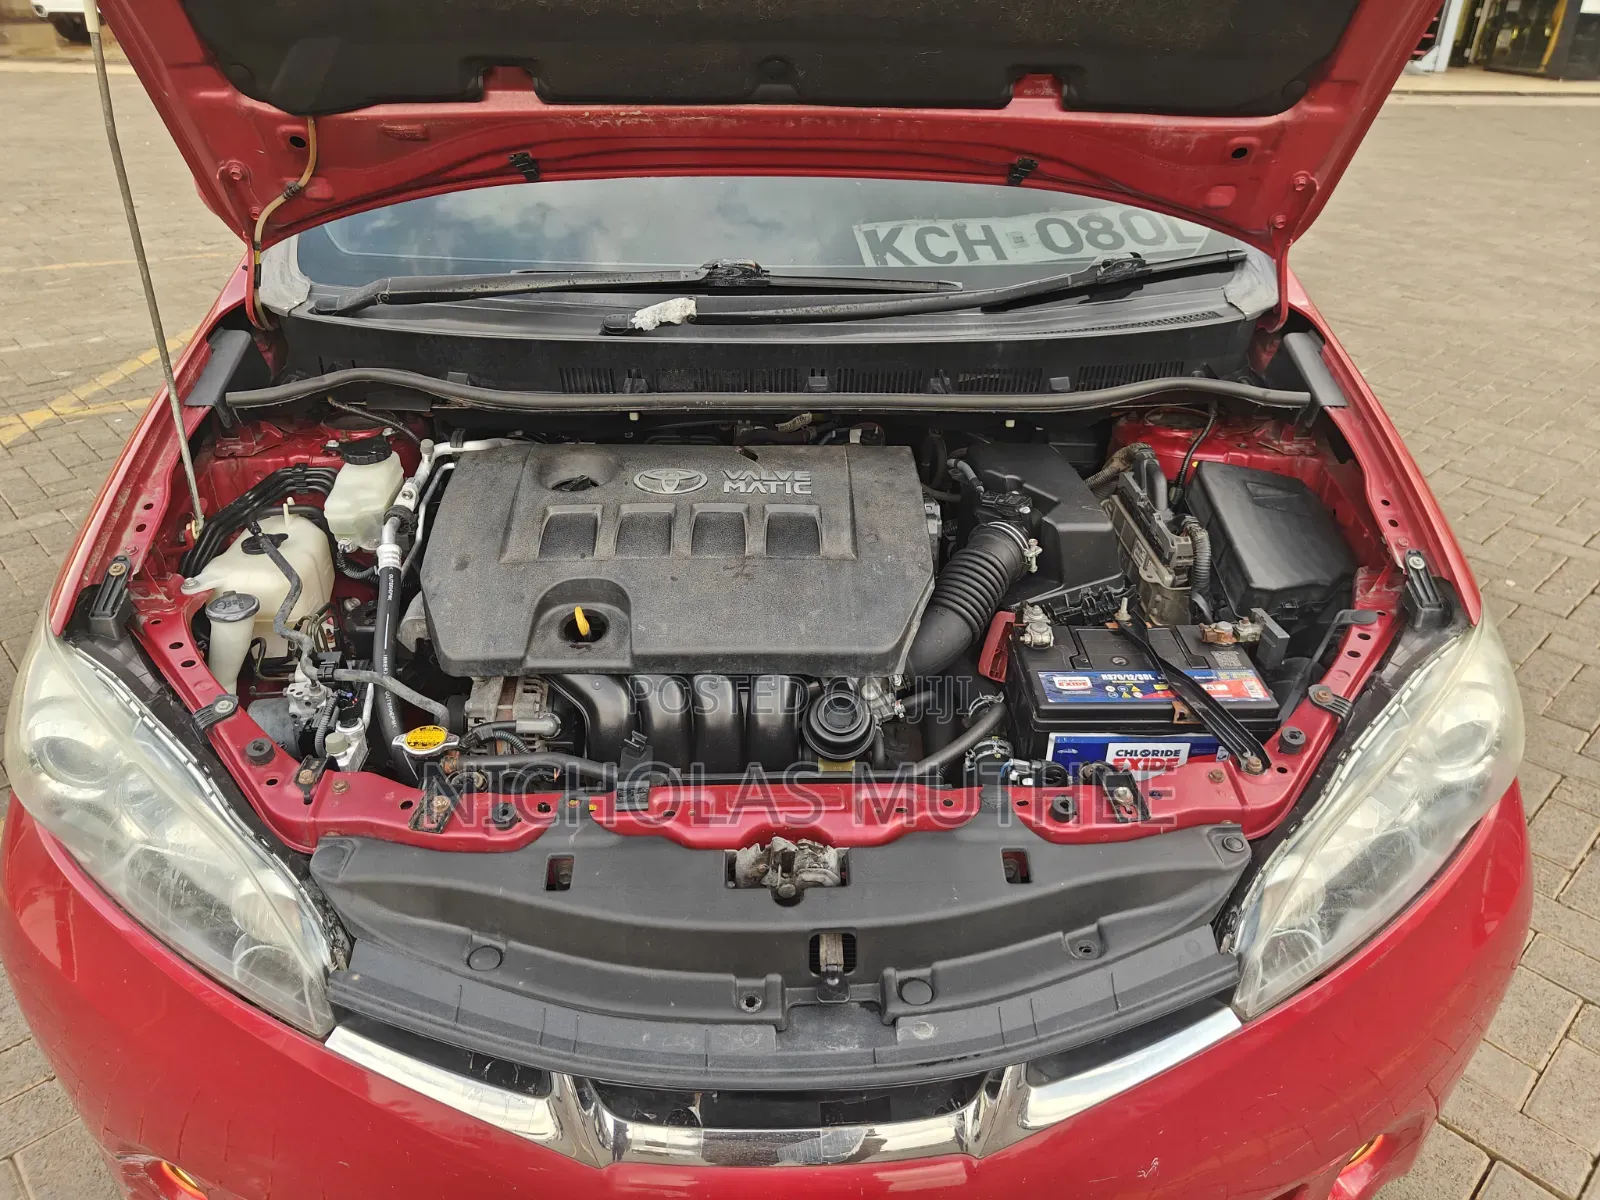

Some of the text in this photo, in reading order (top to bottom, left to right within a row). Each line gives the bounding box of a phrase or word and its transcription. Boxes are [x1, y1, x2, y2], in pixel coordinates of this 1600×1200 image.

[863, 208, 1205, 266] KCH 080L
[723, 469, 811, 481] VALVE
[723, 480, 812, 494] MATIC
[1115, 749, 1181, 757] CHLORIDE
[1112, 757, 1181, 772] EXIDE
